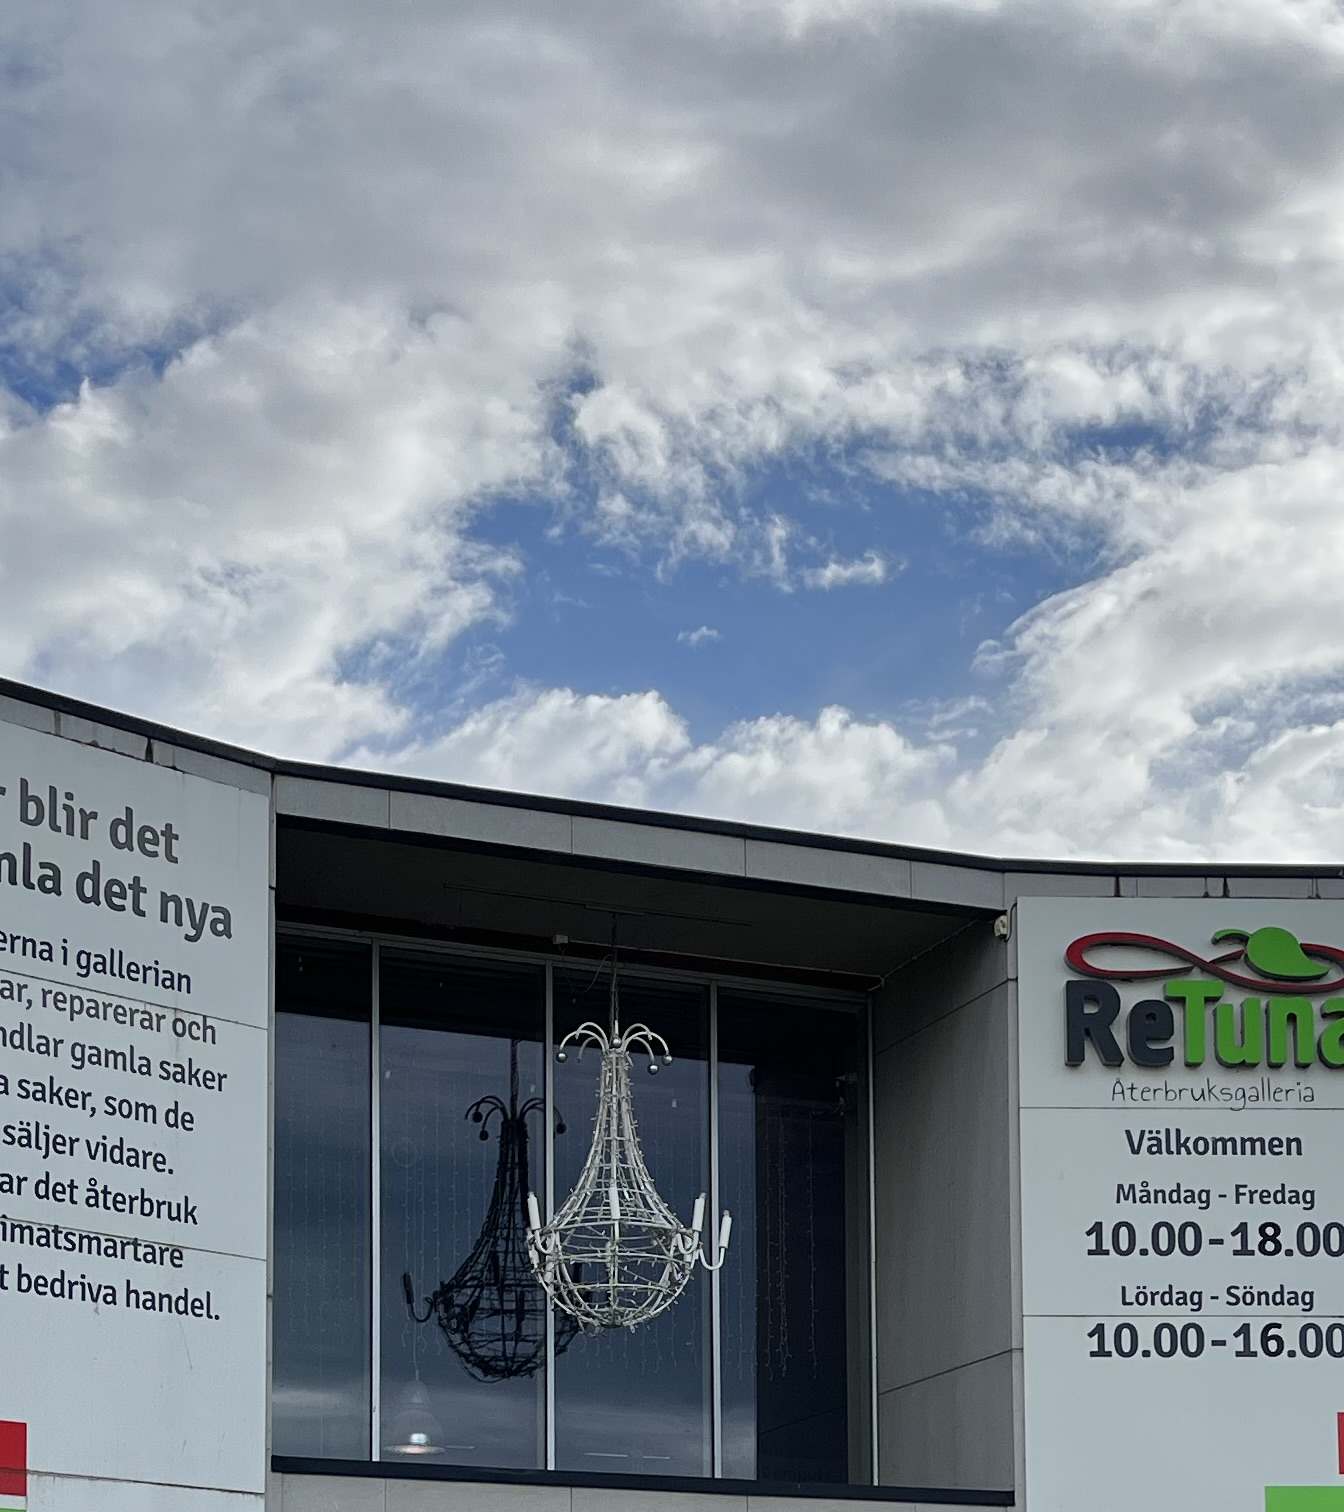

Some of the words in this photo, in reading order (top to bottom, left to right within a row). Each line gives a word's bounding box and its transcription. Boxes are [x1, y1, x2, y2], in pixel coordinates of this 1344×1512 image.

[21, 778, 98, 841] blir
[110, 806, 179, 864] det
[77, 860, 146, 918] det
[160, 888, 232, 944] nya
[62, 938, 68, 966] i
[76, 944, 191, 993] gallerian
[42, 988, 166, 1032] reparerar
[173, 1010, 216, 1044] och
[71, 1040, 152, 1078] gamla
[159, 1058, 228, 1092] saker
[18, 1076, 96, 1116] saker,
[104, 1091, 158, 1125] som
[164, 1101, 194, 1132] de
[1111, 1078, 1315, 1111] Återbruksgalleria
[2, 1119, 79, 1158] säljer
[86, 1134, 174, 1174] vidare.
[1125, 1129, 1302, 1157] Välkommen
[35, 1169, 78, 1206] det
[85, 1178, 198, 1225] återbruk
[1116, 1180, 1210, 1210] Måndag
[1235, 1184, 1315, 1210] Fredag
[16, 1264, 117, 1306] bedriva
[126, 1280, 220, 1320] handel.
[1121, 1285, 1203, 1312] Lördag
[1226, 1285, 1314, 1312] Söndag
